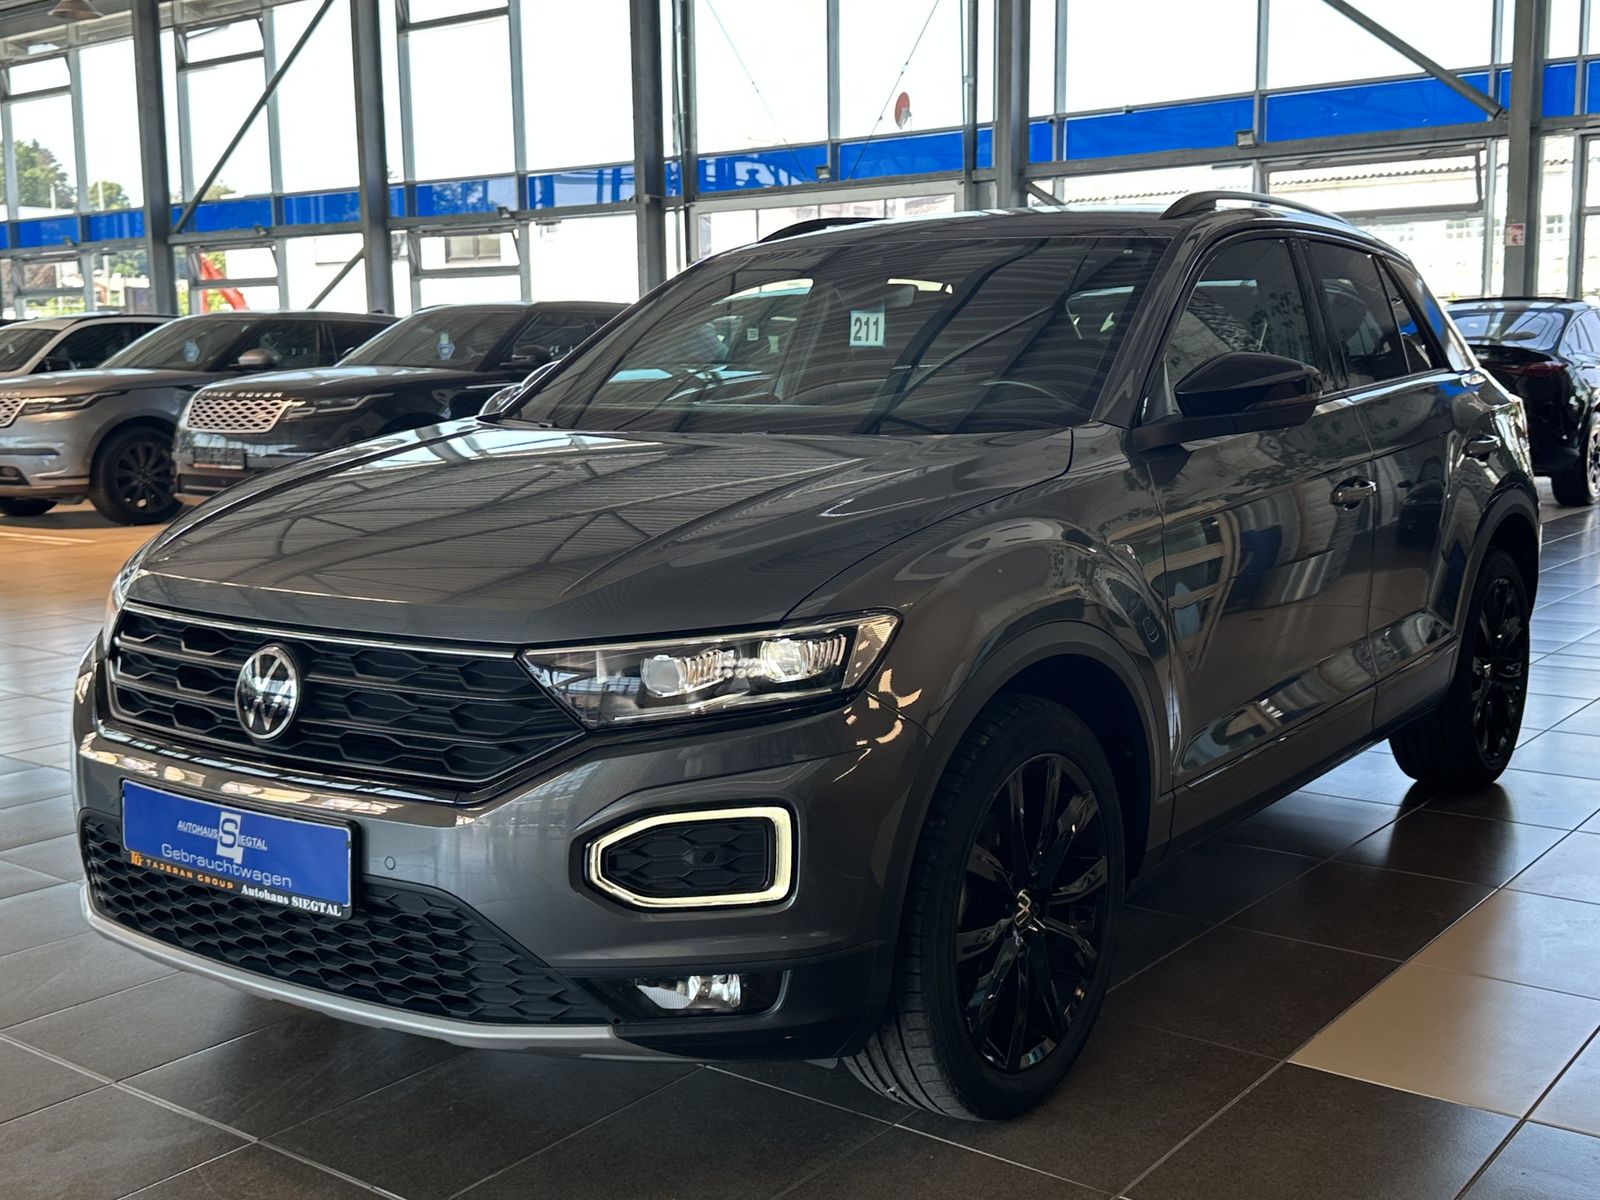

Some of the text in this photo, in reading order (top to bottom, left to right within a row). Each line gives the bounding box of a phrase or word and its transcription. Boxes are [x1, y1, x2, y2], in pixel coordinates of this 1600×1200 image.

[853, 316, 879, 341] 211
[177, 818, 268, 850] AUTOHAUS SIEGTAL
[161, 843, 292, 888] Gebrauchtwagen
[197, 874, 234, 889] GROUP
[241, 884, 342, 917] Autohaus SIEGTAL
